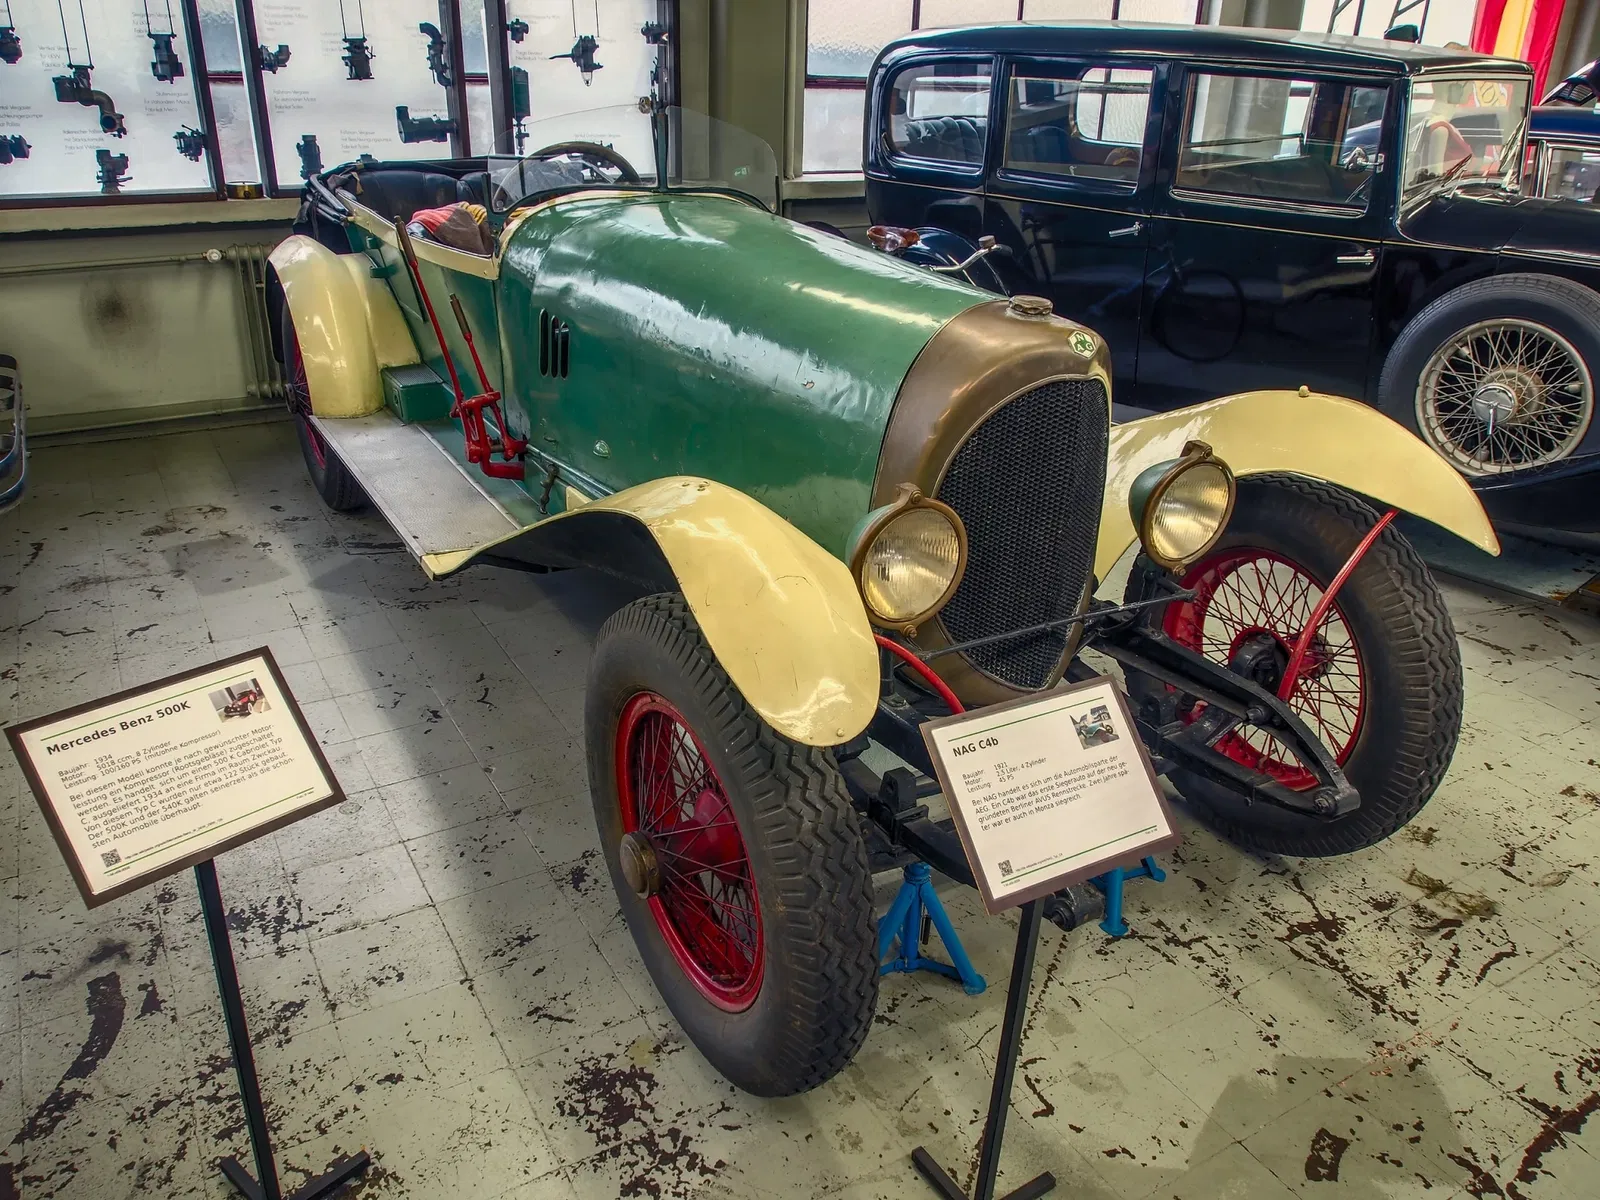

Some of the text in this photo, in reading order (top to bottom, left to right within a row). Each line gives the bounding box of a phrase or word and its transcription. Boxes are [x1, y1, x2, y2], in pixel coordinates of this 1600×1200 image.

[47, 701, 190, 755] Mercedes Benz 500K
[953, 737, 998, 757] NAG C4b
[69, 792, 84, 802] Bei
[86, 782, 116, 796] diesem
[117, 770, 144, 784] Modell
[145, 761, 173, 774] konnte
[183, 750, 202, 760] nach
[204, 733, 249, 754] gewünschter
[251, 725, 273, 735] Motor-
[73, 794, 108, 809] leistung
[109, 788, 122, 796] ein
[123, 770, 169, 791] Kompressor
[229, 732, 274, 752] zugeschaltet
[94, 754, 113, 766] 1934
[97, 760, 117, 772] 5018
[136, 751, 141, 759] 8
[142, 741, 170, 755] Zylinder
[100, 762, 130, 776] 100/160
[144, 746, 178, 761] (mit/ohne
[179, 730, 221, 748] Kompressor)
[994, 762, 1008, 770] 1921
[1025, 758, 1046, 768] Zylinder
[77, 802, 111, 817] werden.
[112, 796, 123, 804] Es
[124, 784, 155, 799] handelt
[159, 777, 176, 787] sich
[177, 772, 190, 780] um
[191, 764, 212, 775] einen
[213, 756, 228, 766] 500
[236, 742, 269, 758] Cabriolet
[269, 737, 282, 745] Typ
[84, 752, 287, 832] Von diesem Typ C wurden nur etwa 122 Stück gebaut.
[93, 799, 141, 821] ausgeliefert
[142, 790, 163, 802] 1934
[165, 786, 175, 794] an
[176, 779, 193, 789] eine
[194, 771, 216, 782] Firma
[228, 758, 250, 769] Raum
[251, 747, 280, 761] Zwickau.
[976, 805, 990, 814] AEG.
[1002, 797, 1015, 806] C4b
[1039, 785, 1054, 794] erste
[1055, 775, 1086, 788] Siegerauto
[1086, 770, 1096, 778] auf
[983, 793, 997, 802] NAG
[998, 786, 1021, 798] handelt
[1030, 779, 1042, 788] sich
[1042, 776, 1053, 784] um
[1064, 759, 1108, 776] Automobilsparte
[1010, 800, 1033, 812] Berliner
[1035, 794, 1051, 804] AVUS
[1088, 778, 1102, 786] Zwei
[1102, 773, 1117, 783] Jahre
[88, 831, 103, 840] Der
[105, 821, 128, 834] 500K
[129, 814, 145, 825] und
[146, 809, 160, 818] der
[162, 800, 183, 812] 540K
[184, 791, 208, 805] galten
[210, 776, 246, 793] seinerzeit
[247, 771, 258, 779] als
[259, 765, 271, 774] die
[1013, 811, 1028, 821] auch
[1034, 803, 1054, 813] Monza
[92, 838, 111, 849] sten
[113, 819, 158, 840] Automobile
[160, 802, 201, 821] überhaupt.
